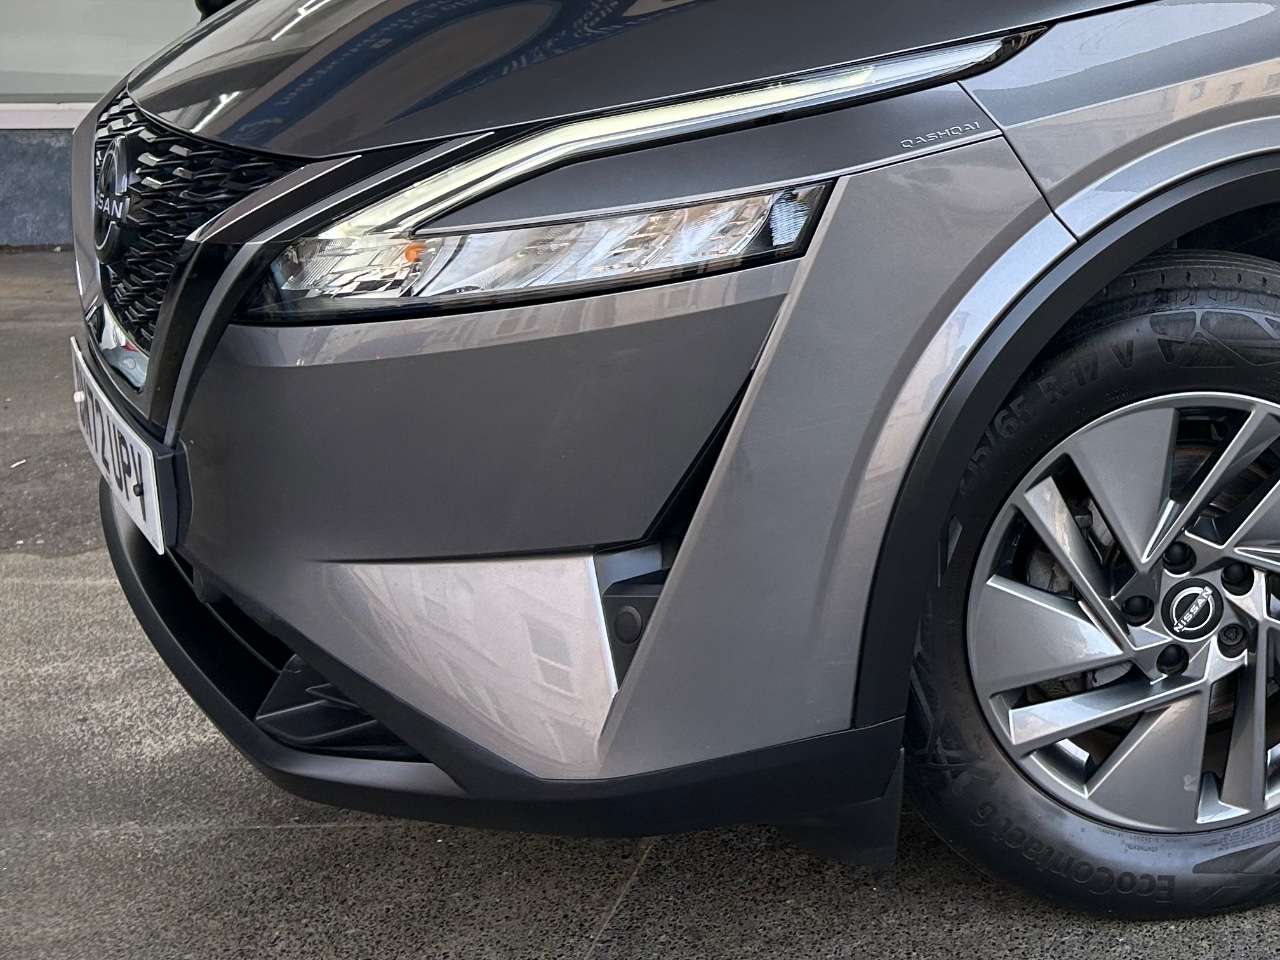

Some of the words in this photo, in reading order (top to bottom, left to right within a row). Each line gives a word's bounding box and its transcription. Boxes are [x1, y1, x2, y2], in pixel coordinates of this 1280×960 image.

[900, 121, 980, 148] QASHQAI
[1174, 586, 1213, 633] NISSAN
[995, 815, 1176, 904] EcoContact
